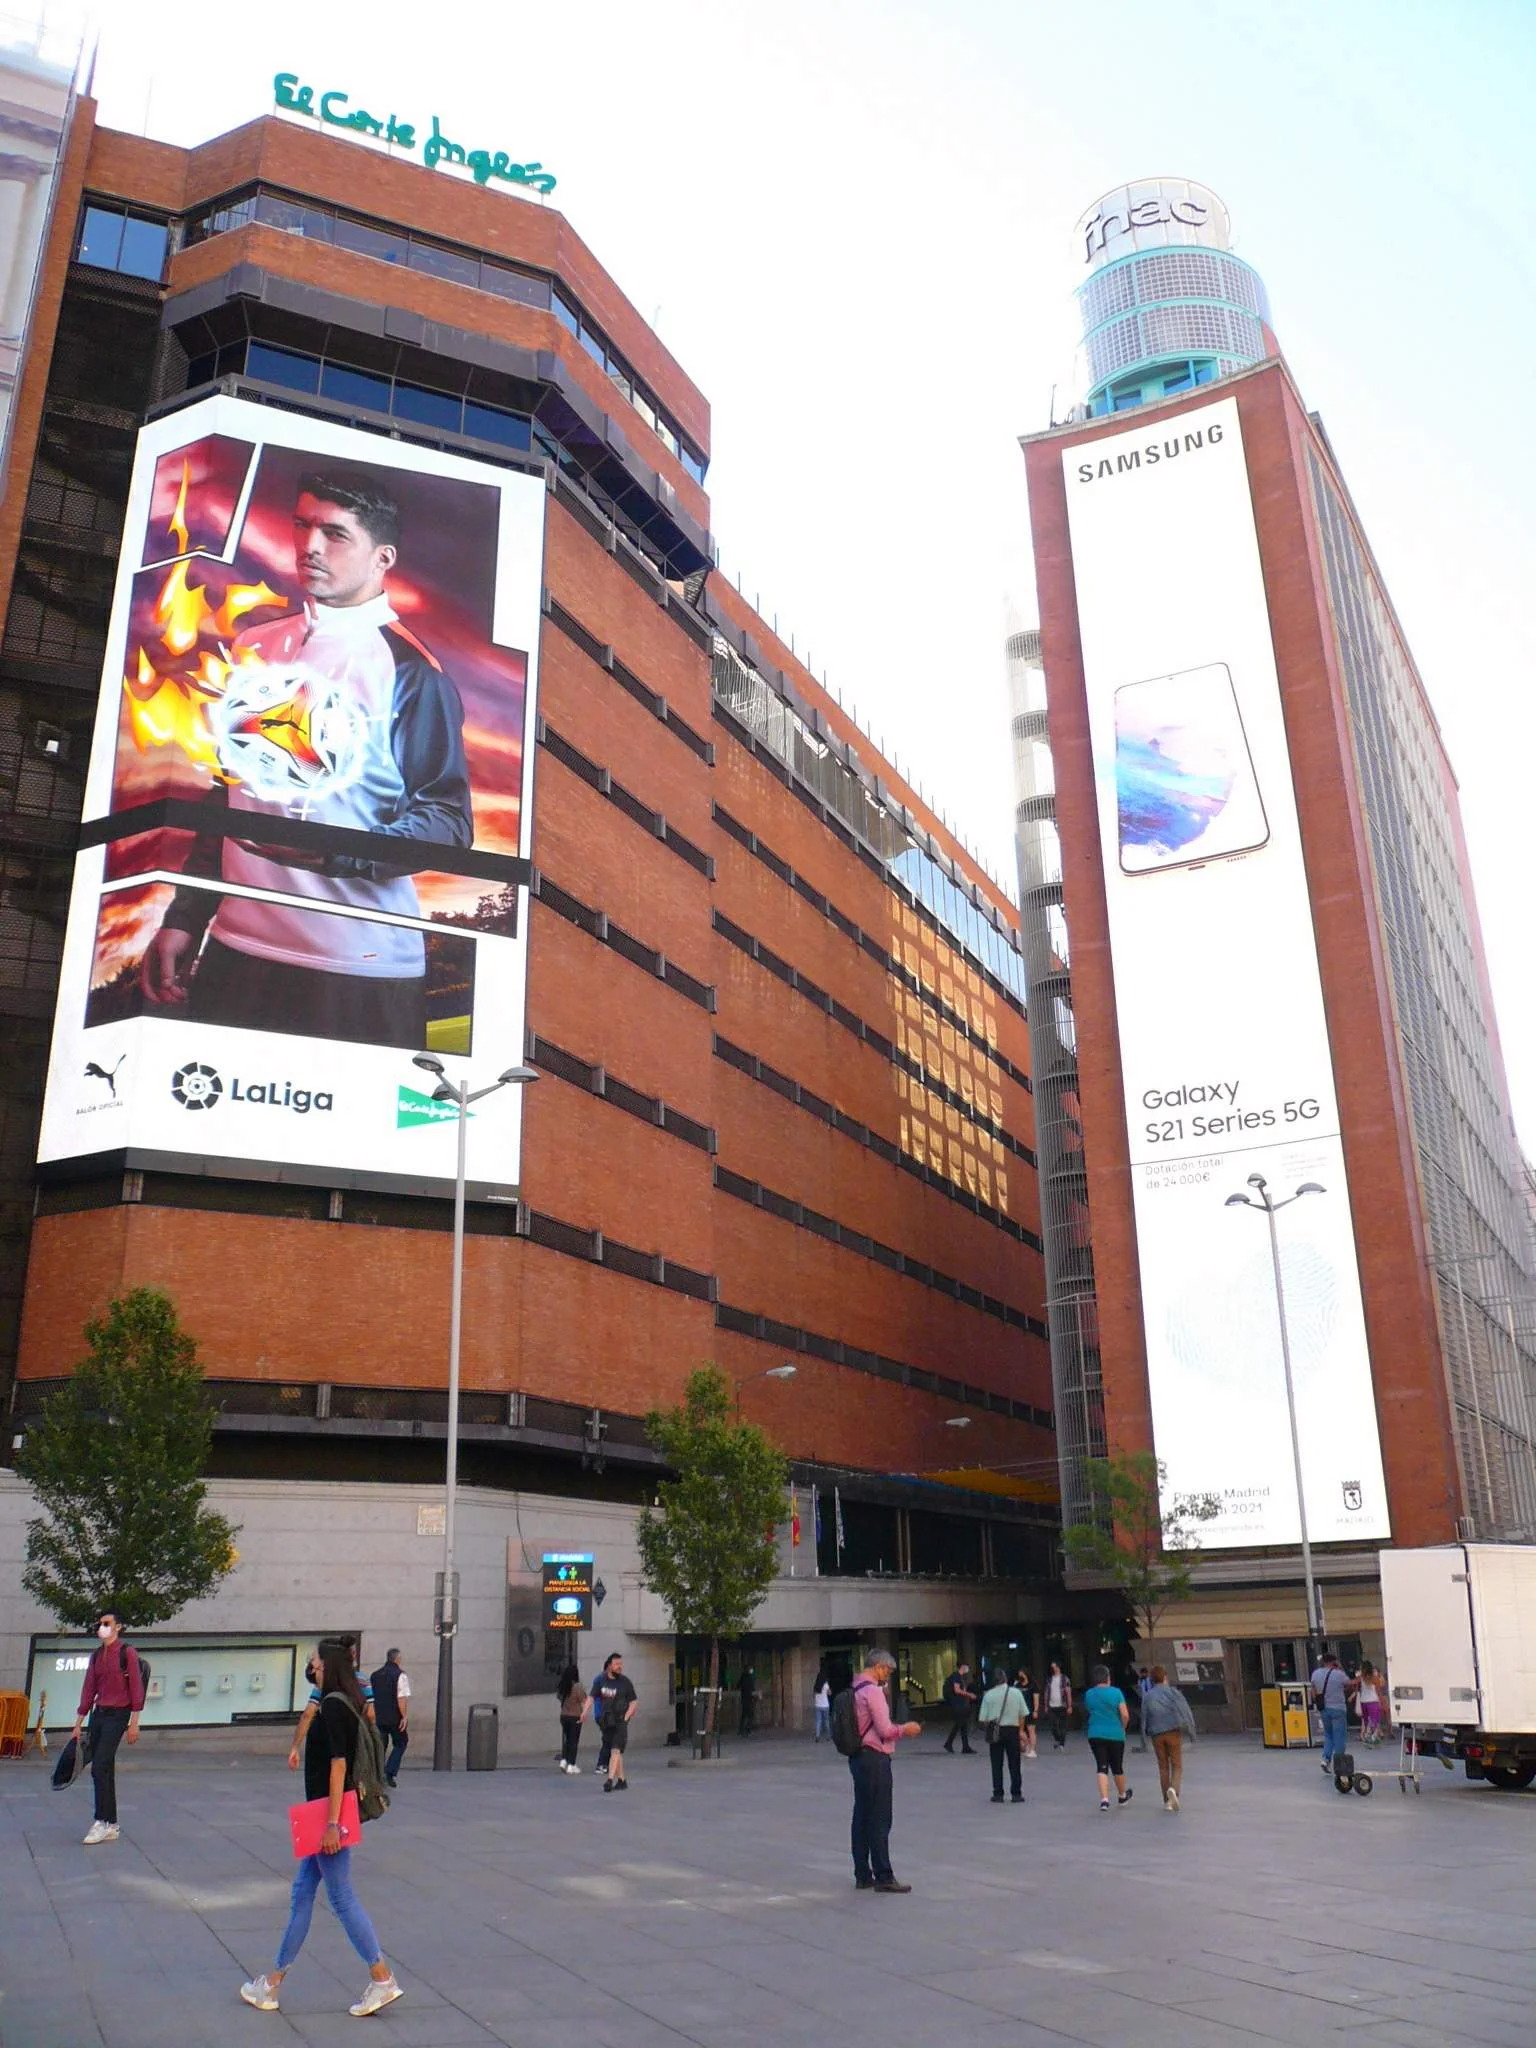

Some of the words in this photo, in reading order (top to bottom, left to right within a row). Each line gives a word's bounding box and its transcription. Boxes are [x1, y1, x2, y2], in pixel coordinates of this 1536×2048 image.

[274, 72, 314, 115] El
[321, 91, 416, 149] Corte
[424, 115, 557, 195] Inglés
[1084, 198, 1209, 264] fnac
[1078, 424, 1224, 483] SAMSUNG
[231, 1078, 334, 1114] LaLiga
[1142, 1080, 1240, 1110] Galaxy
[1145, 1119, 1185, 1143] S21
[1192, 1108, 1276, 1137] Series
[1283, 1099, 1321, 1122] 5G
[1145, 1161, 1195, 1176] Dotación
[1197, 1156, 1224, 1169] total
[1224, 1486, 1270, 1499] Madrid
[1231, 1502, 1263, 1514] 2021
[55, 1656, 90, 1671] SAM
